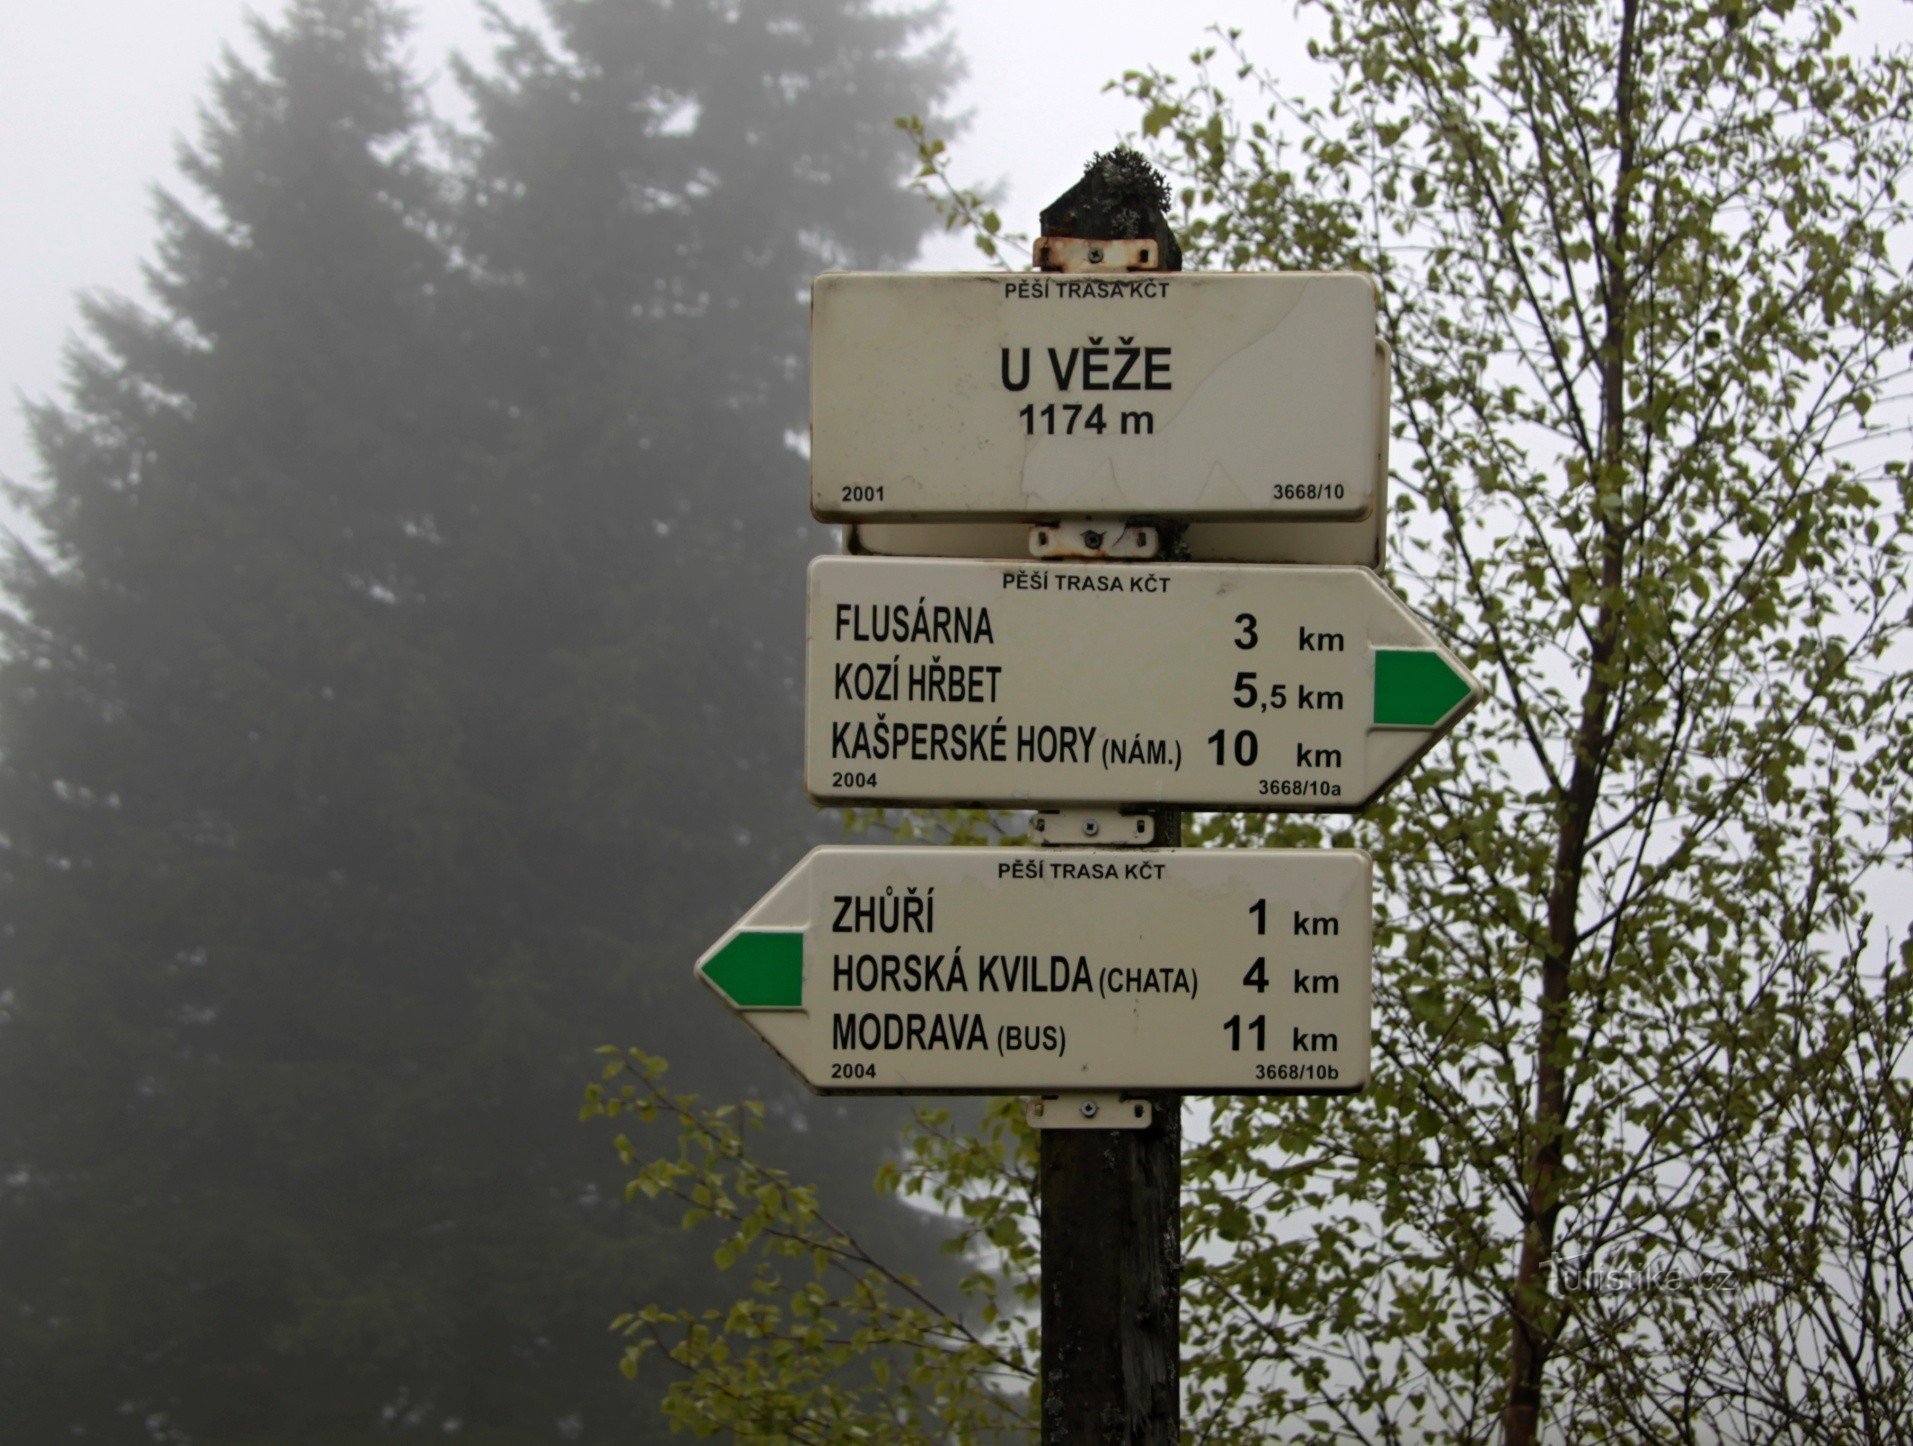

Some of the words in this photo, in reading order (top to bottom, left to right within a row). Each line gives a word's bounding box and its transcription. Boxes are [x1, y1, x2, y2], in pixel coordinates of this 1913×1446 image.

[1005, 279, 1048, 298] PĚŠÍ
[1056, 283, 1122, 298] TRASA
[1130, 279, 1169, 298] KČT
[1002, 348, 1030, 390] U
[1048, 336, 1172, 390] VĚŽE
[1019, 403, 1107, 435] 1174
[1121, 411, 1153, 434] m
[842, 486, 884, 501] 2001
[1273, 484, 1345, 500] 3668/10
[1003, 570, 1048, 590] PĚŠÍ
[1055, 575, 1123, 592] TRASA
[1131, 574, 1171, 592] KČT
[836, 596, 994, 644] FLUSÁRNA
[1234, 613, 1258, 650] 3
[1299, 626, 1344, 651] km
[835, 655, 899, 701] KOZÍ
[909, 656, 1002, 703] HŘBET
[1233, 672, 1287, 713] 5,5
[1299, 685, 1343, 709] km
[832, 713, 1006, 761] KAŠPERSKÉ
[1017, 725, 1096, 763] HORY
[1102, 733, 1182, 771] (NÁM.)
[1208, 729, 1258, 766] 10
[1297, 743, 1341, 768] km
[832, 772, 877, 787] 2004
[1259, 780, 1341, 796] 3668/10a
[998, 859, 1043, 879] PĚŠÍ
[1050, 863, 1118, 880] TRASA
[1125, 860, 1165, 880] KČT
[832, 886, 934, 933] ZHŮŘÍ
[1249, 899, 1266, 935] 1
[1294, 911, 1338, 935] km
[833, 946, 968, 992] HORSKÁ
[979, 955, 1093, 992] KVILDA
[1100, 968, 1198, 999] (CHATA)
[1243, 957, 1269, 993] 4
[1294, 969, 1339, 993] km
[833, 1013, 988, 1050] MODRAVA
[998, 1025, 1066, 1057] (BUS)
[1223, 1015, 1266, 1051] 11
[1293, 1027, 1337, 1051] km
[831, 1063, 876, 1078] 2004
[1256, 1064, 1338, 1080] 3668/10b
